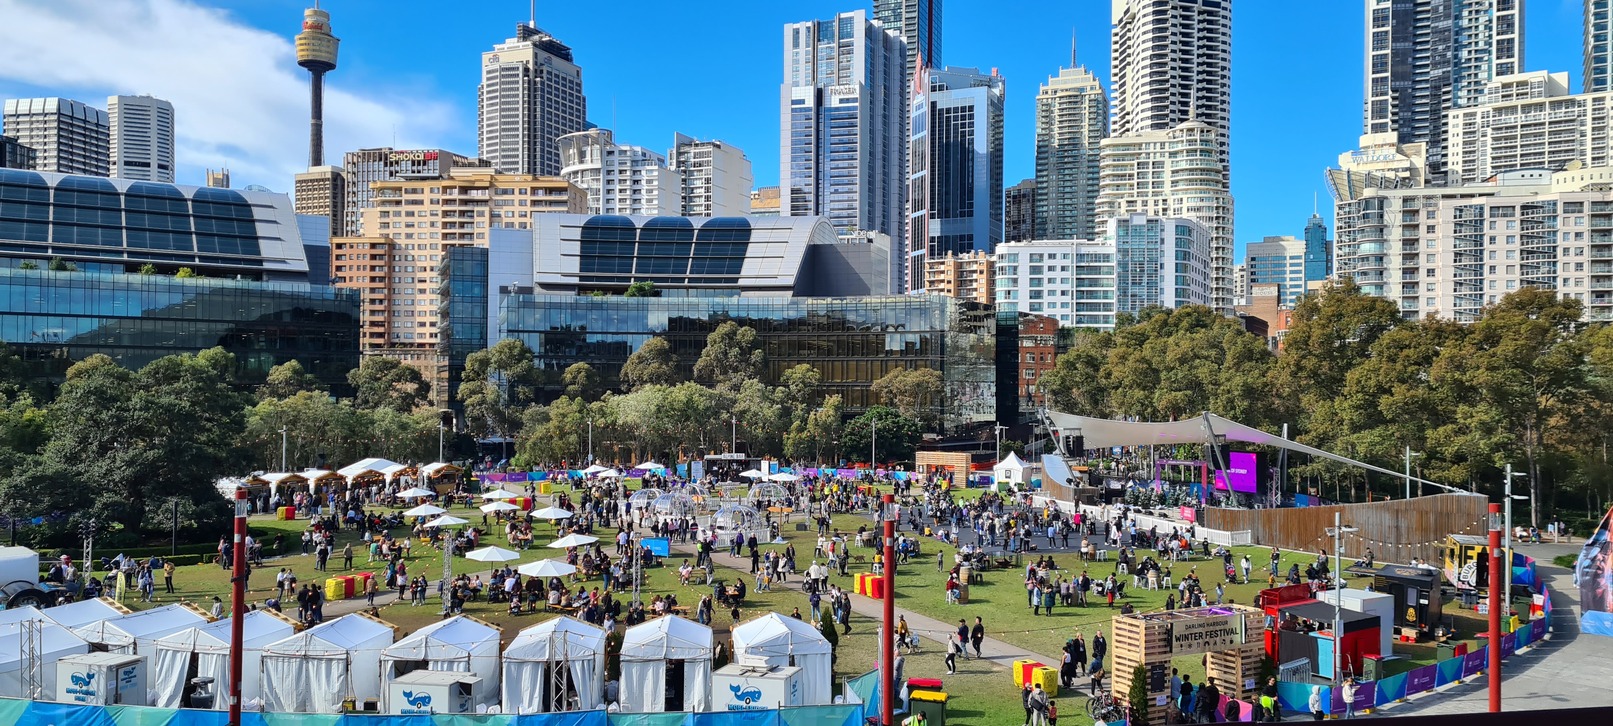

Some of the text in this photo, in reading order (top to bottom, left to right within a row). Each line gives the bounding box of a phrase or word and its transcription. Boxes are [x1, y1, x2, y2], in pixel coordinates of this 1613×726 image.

[1351, 153, 1396, 163] WALDORF
[1185, 620, 1229, 631] DARLING HARBOUR
[1175, 627, 1240, 643] WINTER FESTIVAL
